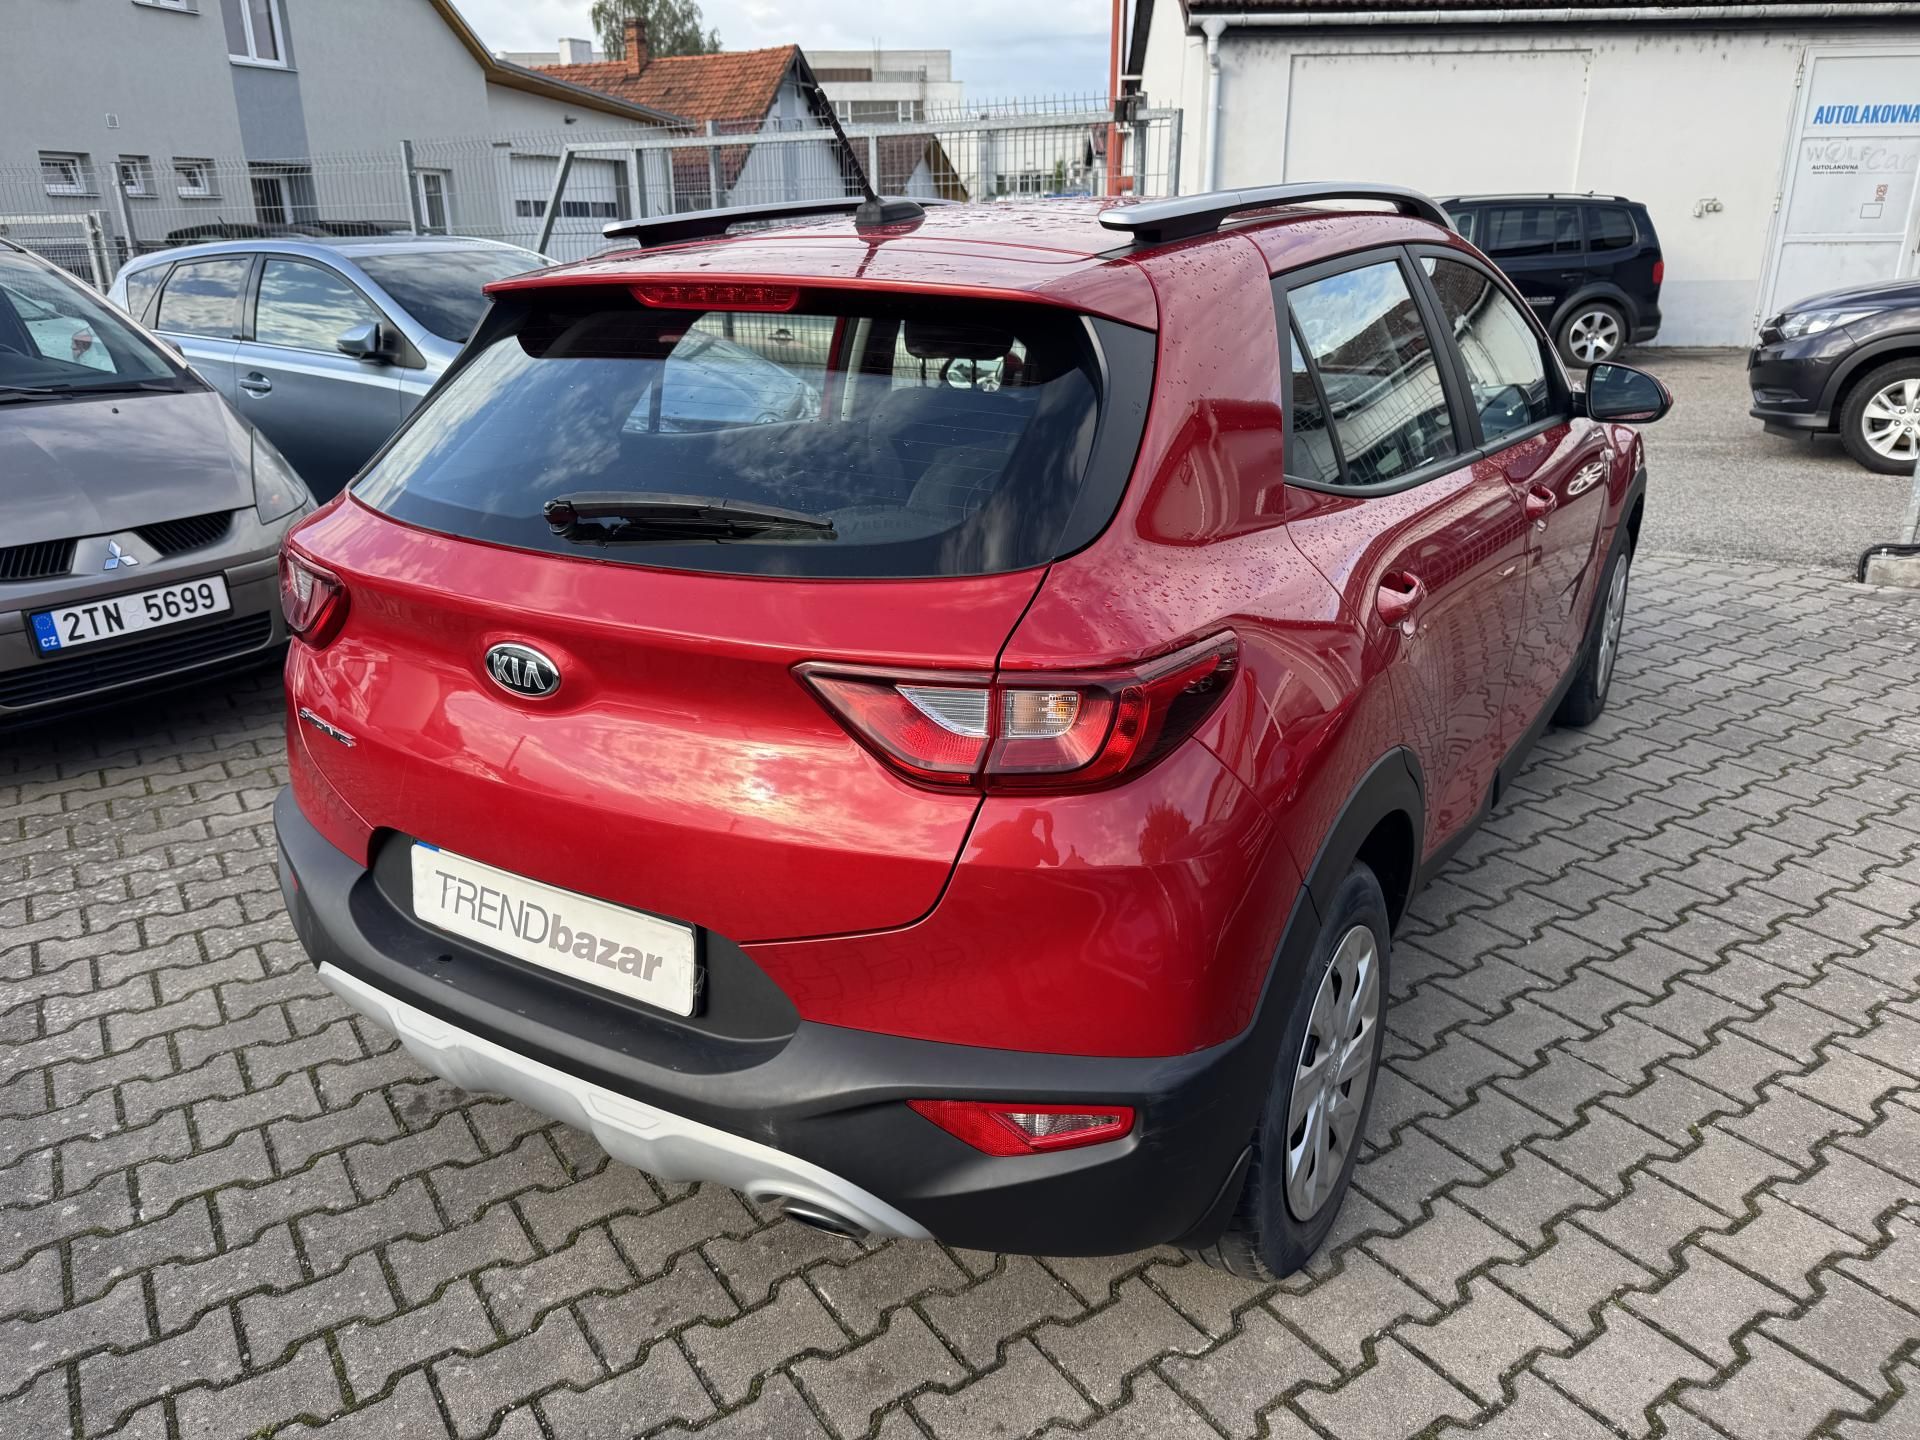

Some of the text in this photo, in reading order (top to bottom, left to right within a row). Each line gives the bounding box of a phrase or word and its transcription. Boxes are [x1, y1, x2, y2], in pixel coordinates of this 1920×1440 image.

[1813, 104, 1920, 124] AUTOLAKOVNA
[63, 583, 215, 642] 2TN 5699
[41, 635, 58, 648] CZ
[493, 653, 546, 689] KIA
[435, 869, 664, 982] TRENDbazar
